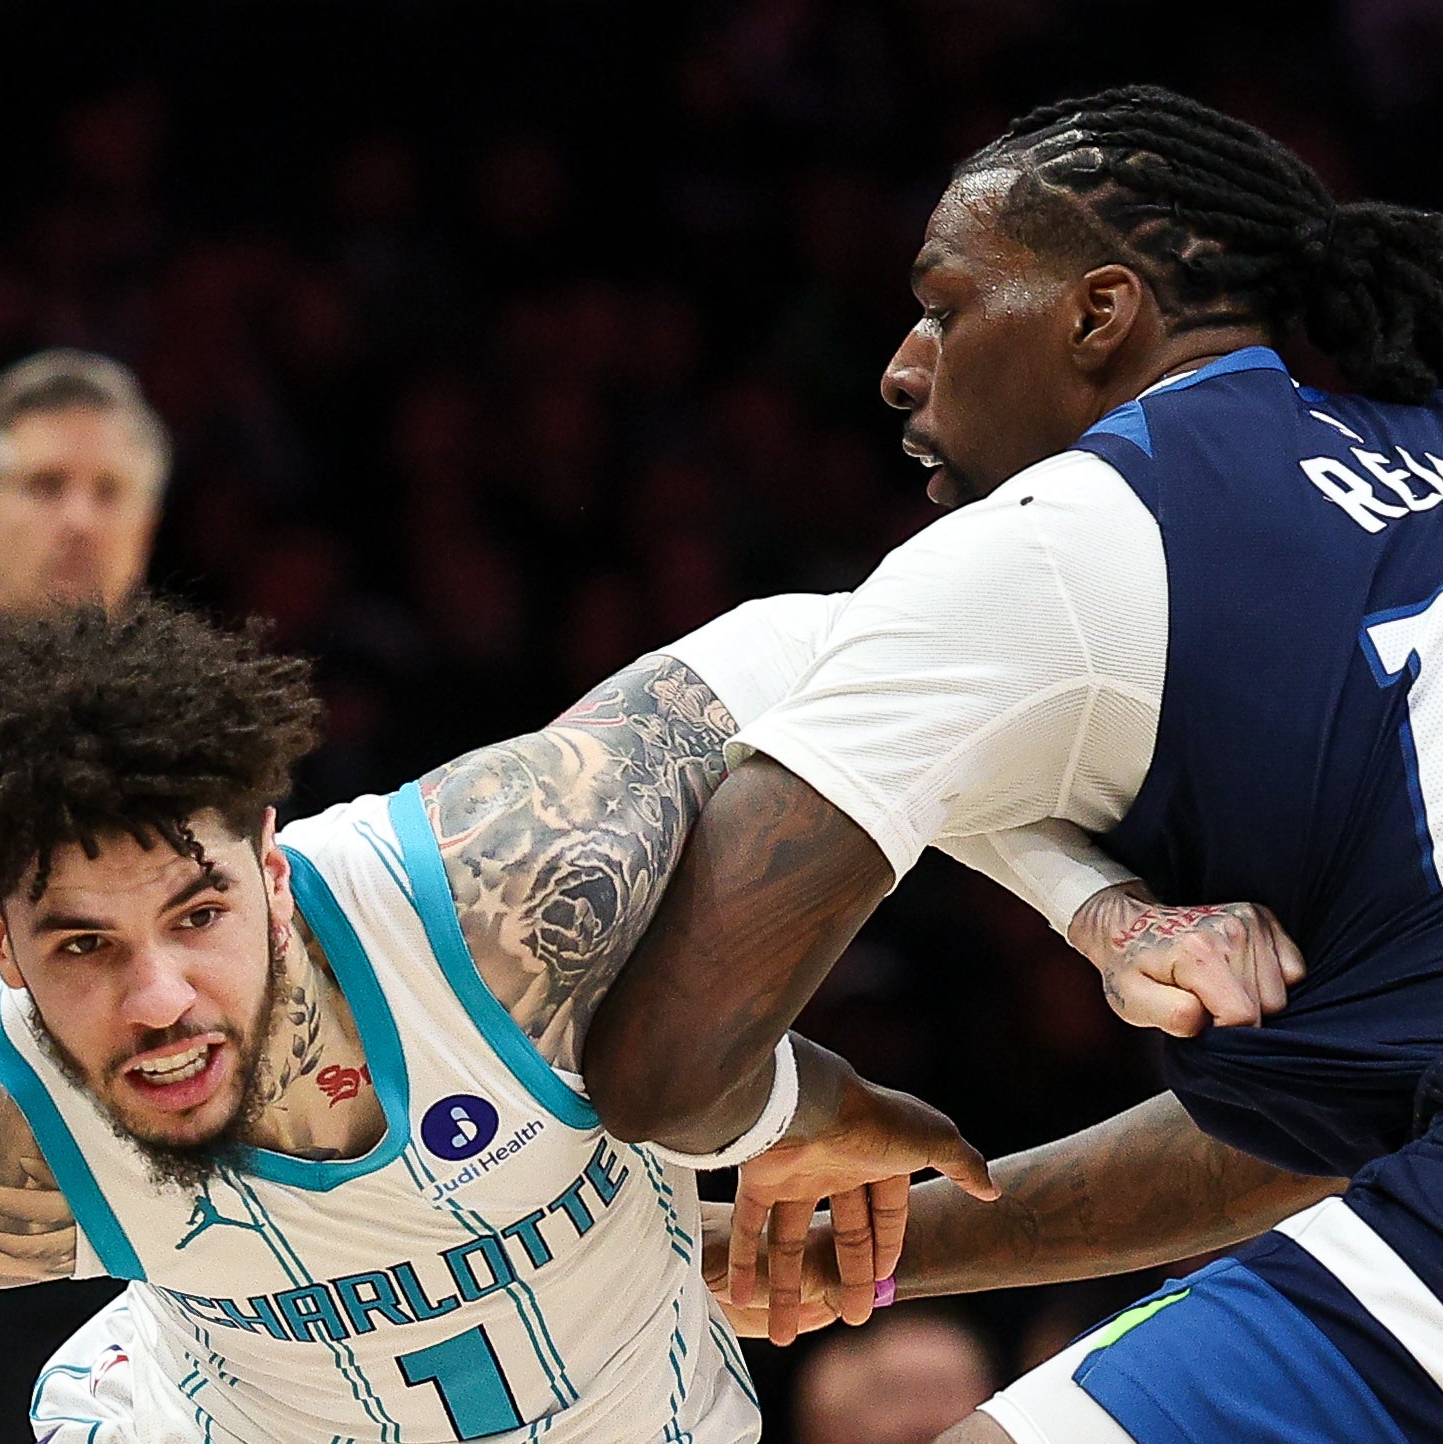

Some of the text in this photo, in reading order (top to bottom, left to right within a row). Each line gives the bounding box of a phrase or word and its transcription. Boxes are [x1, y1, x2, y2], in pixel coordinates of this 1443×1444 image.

[431, 1117, 546, 1203] Judi Health
[159, 1141, 631, 1343] CHARLOTTE
[396, 1322, 525, 1442] 1
